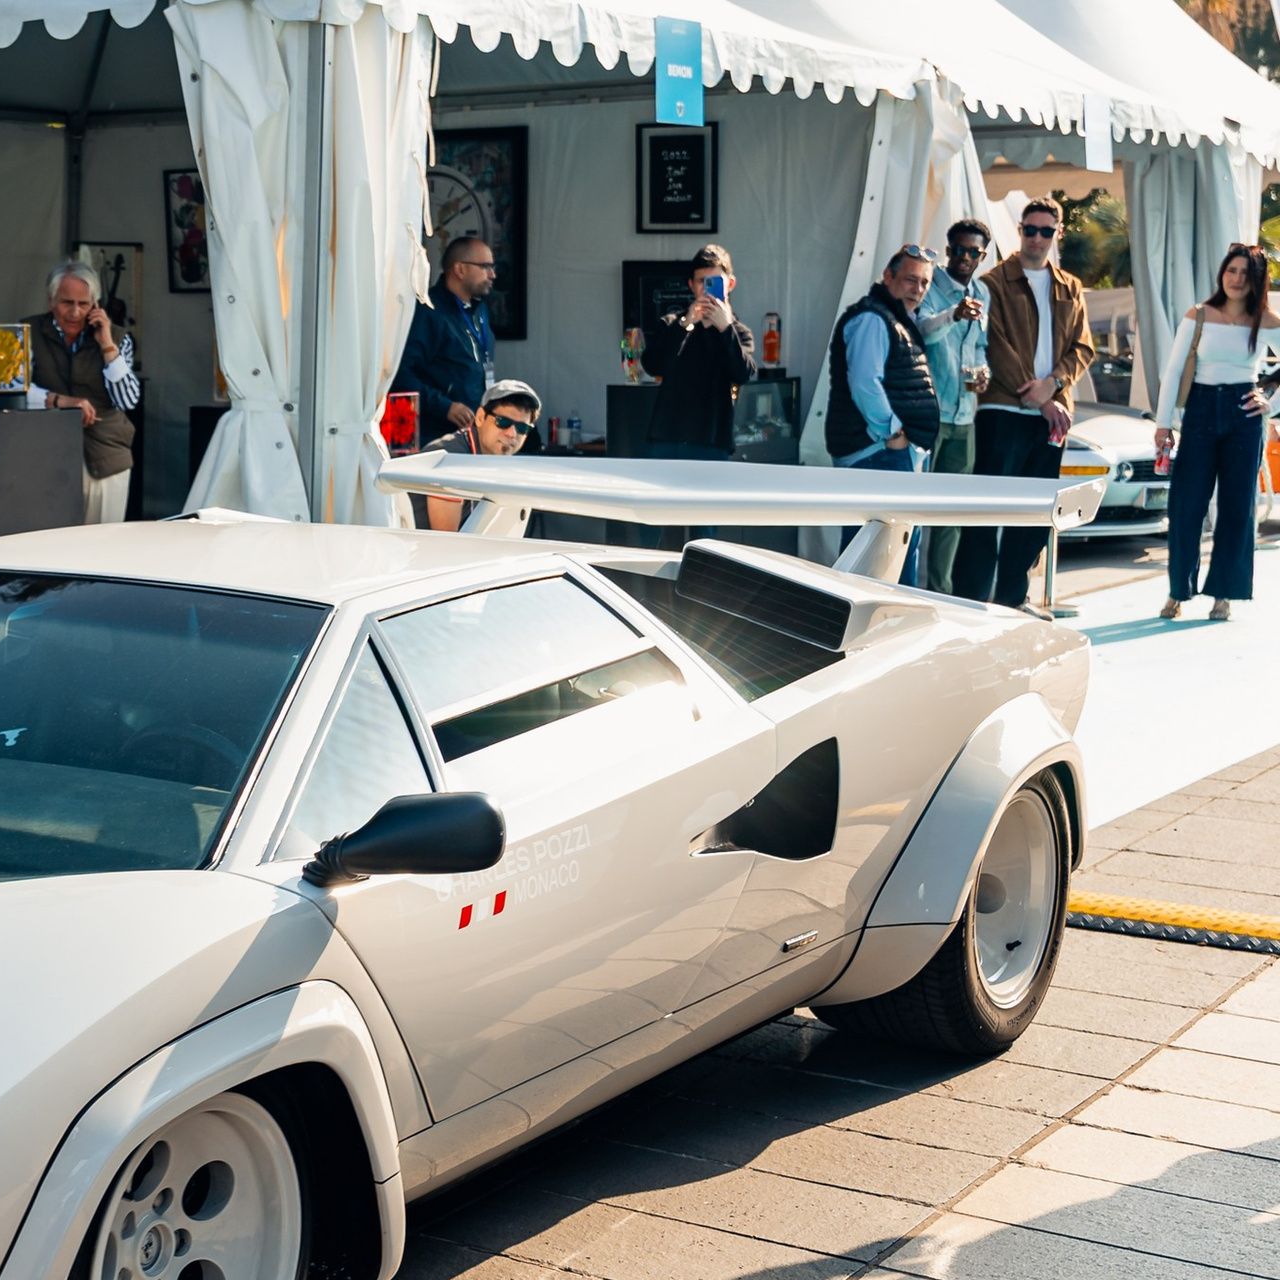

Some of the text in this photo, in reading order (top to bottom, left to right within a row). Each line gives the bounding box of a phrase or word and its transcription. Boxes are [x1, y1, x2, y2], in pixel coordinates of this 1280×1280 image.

[436, 824, 591, 902] CHARLES POZZI
[514, 860, 580, 905] MONACO
